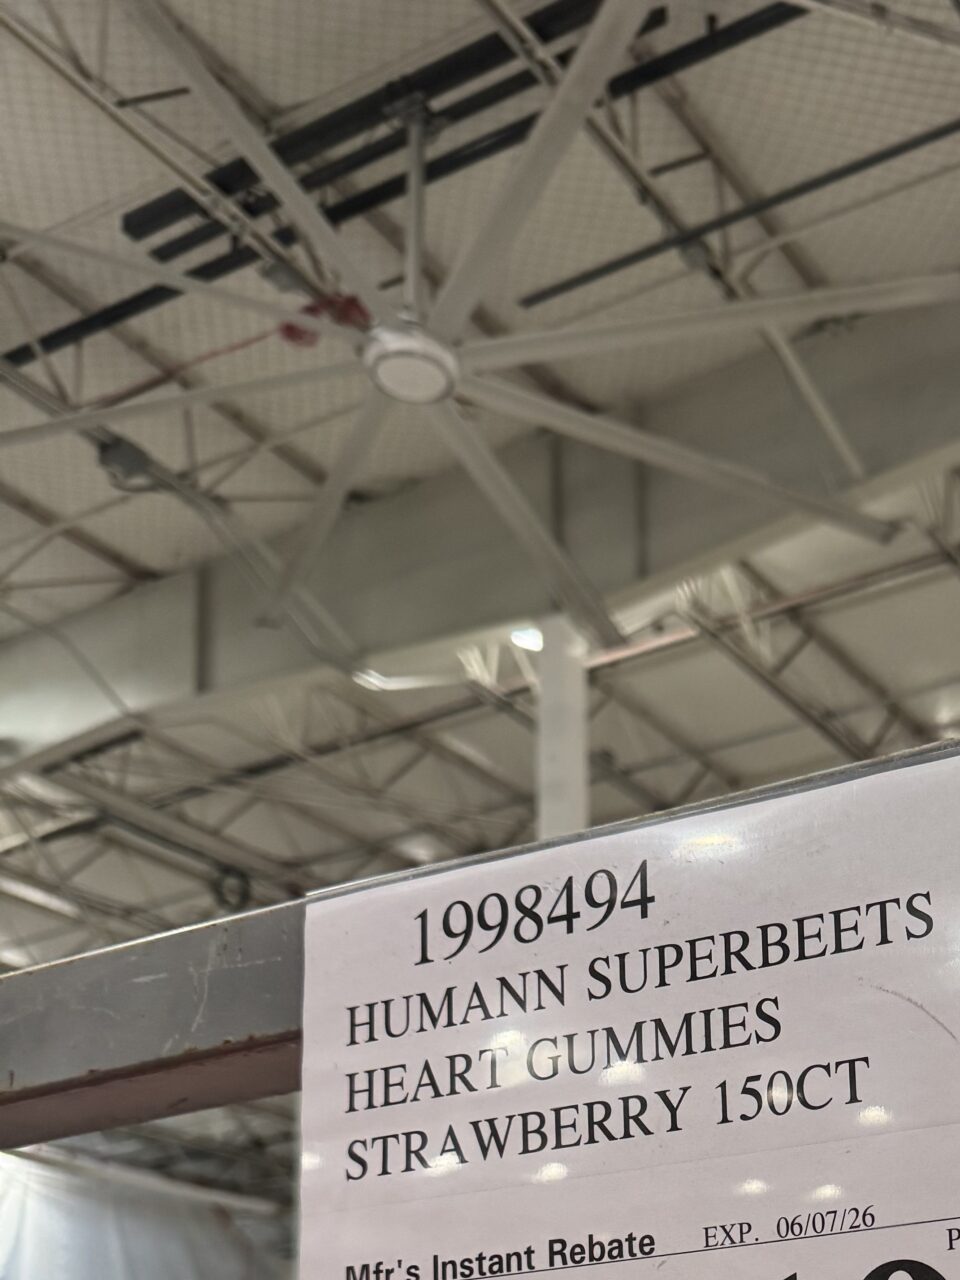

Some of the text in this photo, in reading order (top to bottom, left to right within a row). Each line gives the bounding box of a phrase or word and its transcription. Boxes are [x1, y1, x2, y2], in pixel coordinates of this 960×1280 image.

[345, 890, 934, 1047] HUMANN SUPERBEETS
[413, 859, 656, 967] 1998494
[344, 995, 782, 1114] HEART GUMMIES
[345, 1056, 870, 1182] STRAWBERRY 150CT
[548, 1231, 656, 1268] Rebate
[702, 1204, 876, 1249] EXP. 06/07/26
